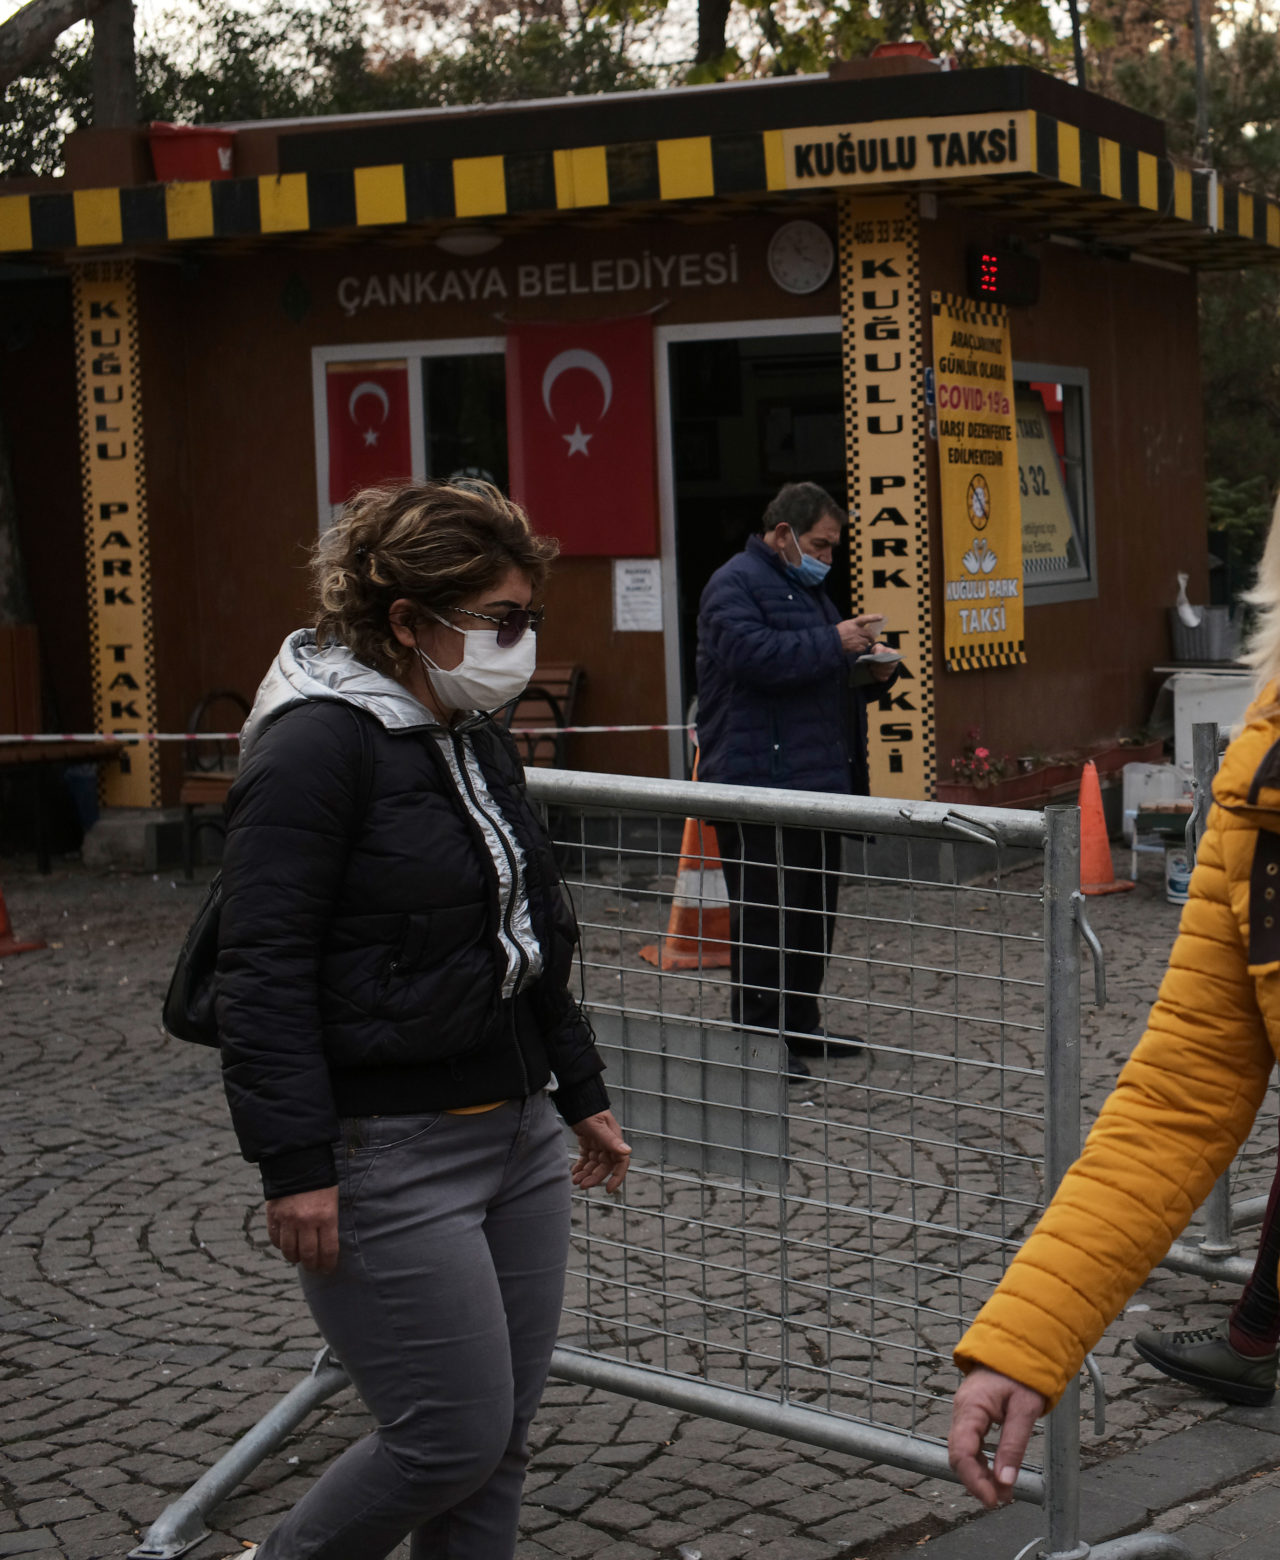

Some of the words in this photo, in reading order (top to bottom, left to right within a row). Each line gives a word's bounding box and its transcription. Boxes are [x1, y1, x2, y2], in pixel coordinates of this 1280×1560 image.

[794, 131, 917, 179] KUĞULU
[926, 119, 1018, 168] TAKSİ
[336, 266, 508, 316] ÇANKAYA
[516, 244, 740, 298] BELEDİYESİ
[89, 300, 128, 461] KUĞULU
[860, 258, 904, 435] KUĞULU
[99, 502, 136, 606] PARK
[868, 475, 912, 589] PARK
[959, 600, 1007, 634] TAKSİ
